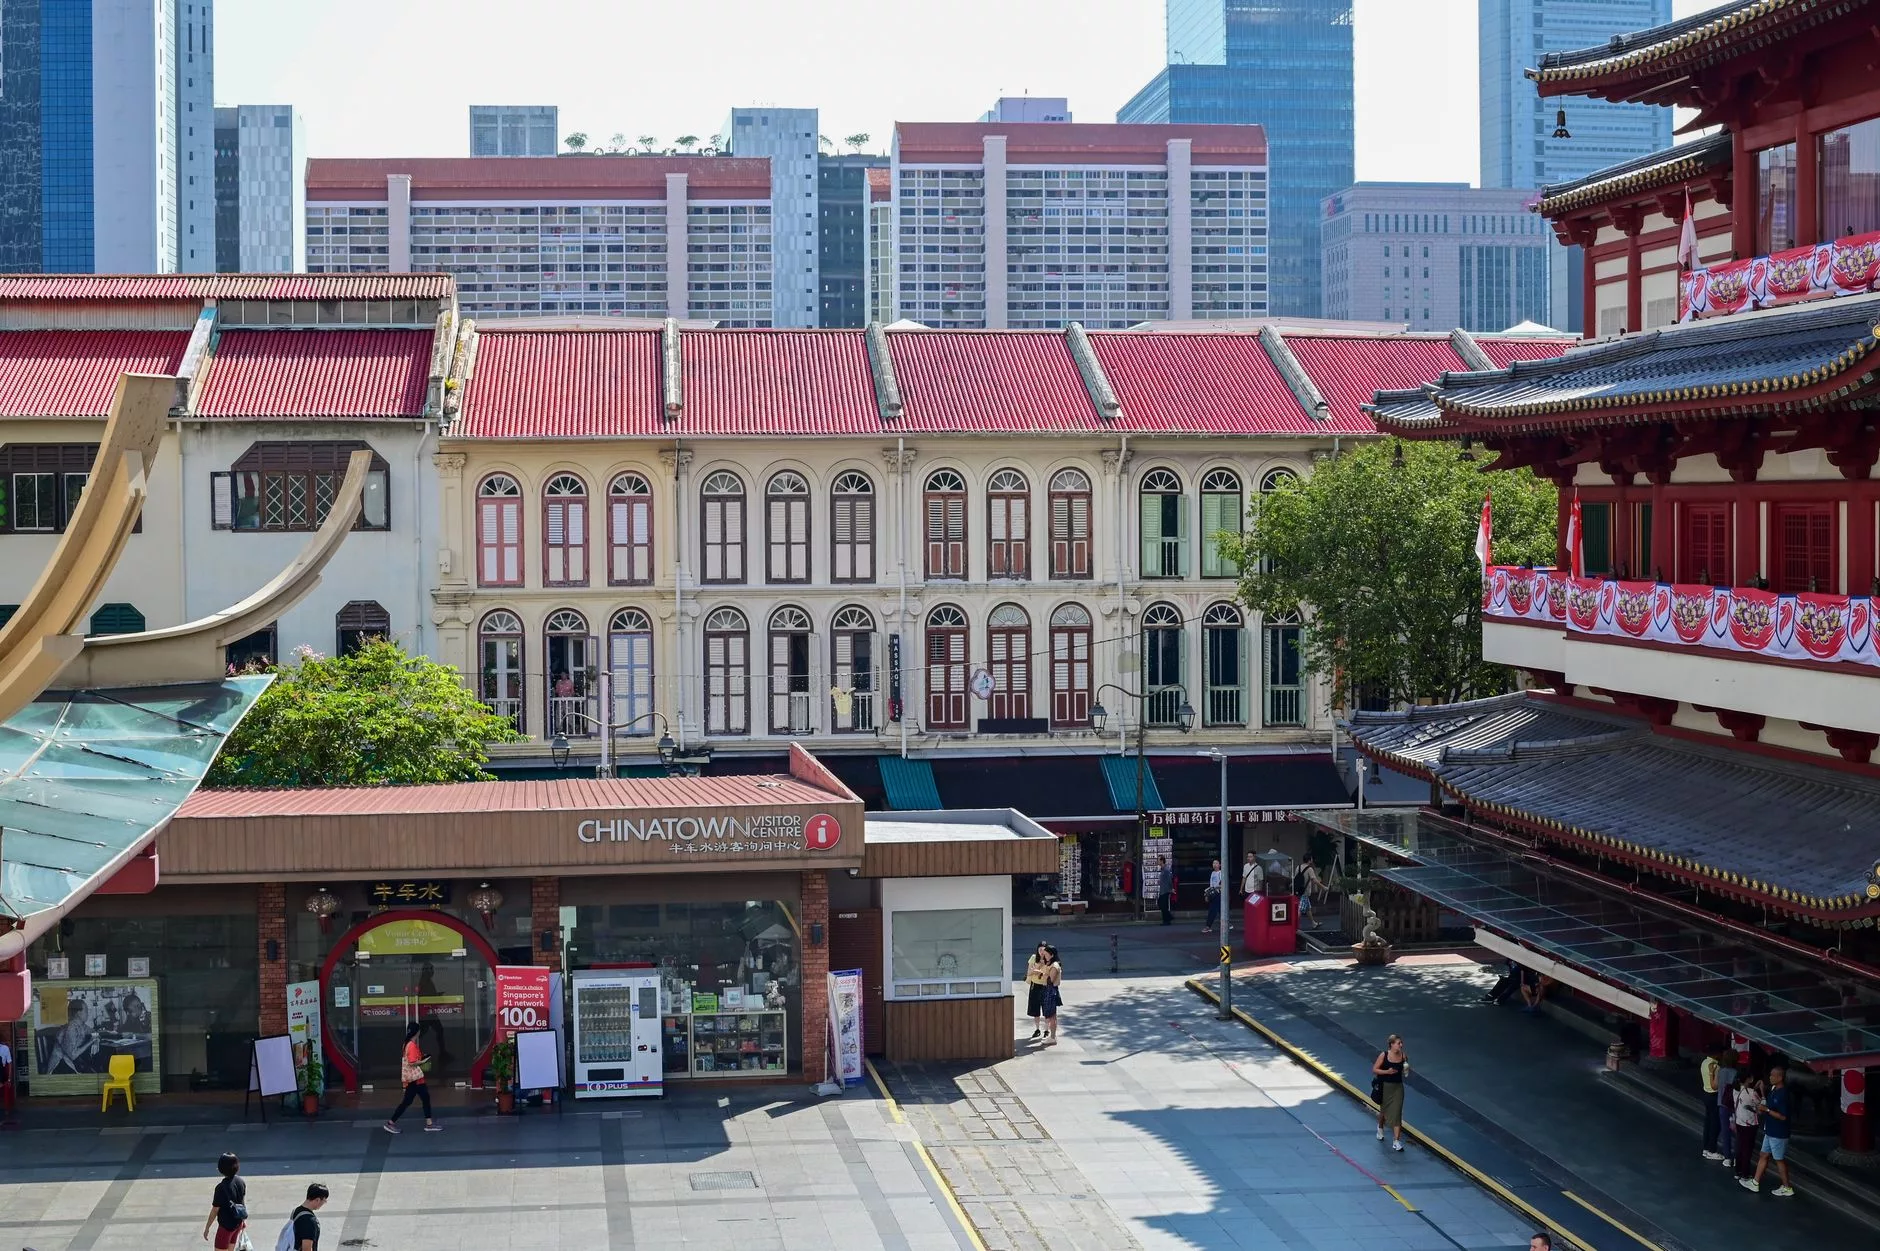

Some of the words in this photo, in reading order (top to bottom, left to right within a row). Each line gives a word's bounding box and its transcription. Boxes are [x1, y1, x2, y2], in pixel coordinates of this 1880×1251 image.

[1151, 812, 1216, 824] 万裕和药行
[577, 816, 749, 843] CHINATOWN
[751, 815, 801, 826] VISITOR
[751, 827, 801, 838] CENTRE
[669, 840, 802, 854] 牛车水游客询问中心
[373, 882, 443, 901] 牛车水
[502, 991, 544, 1000] Singapore's
